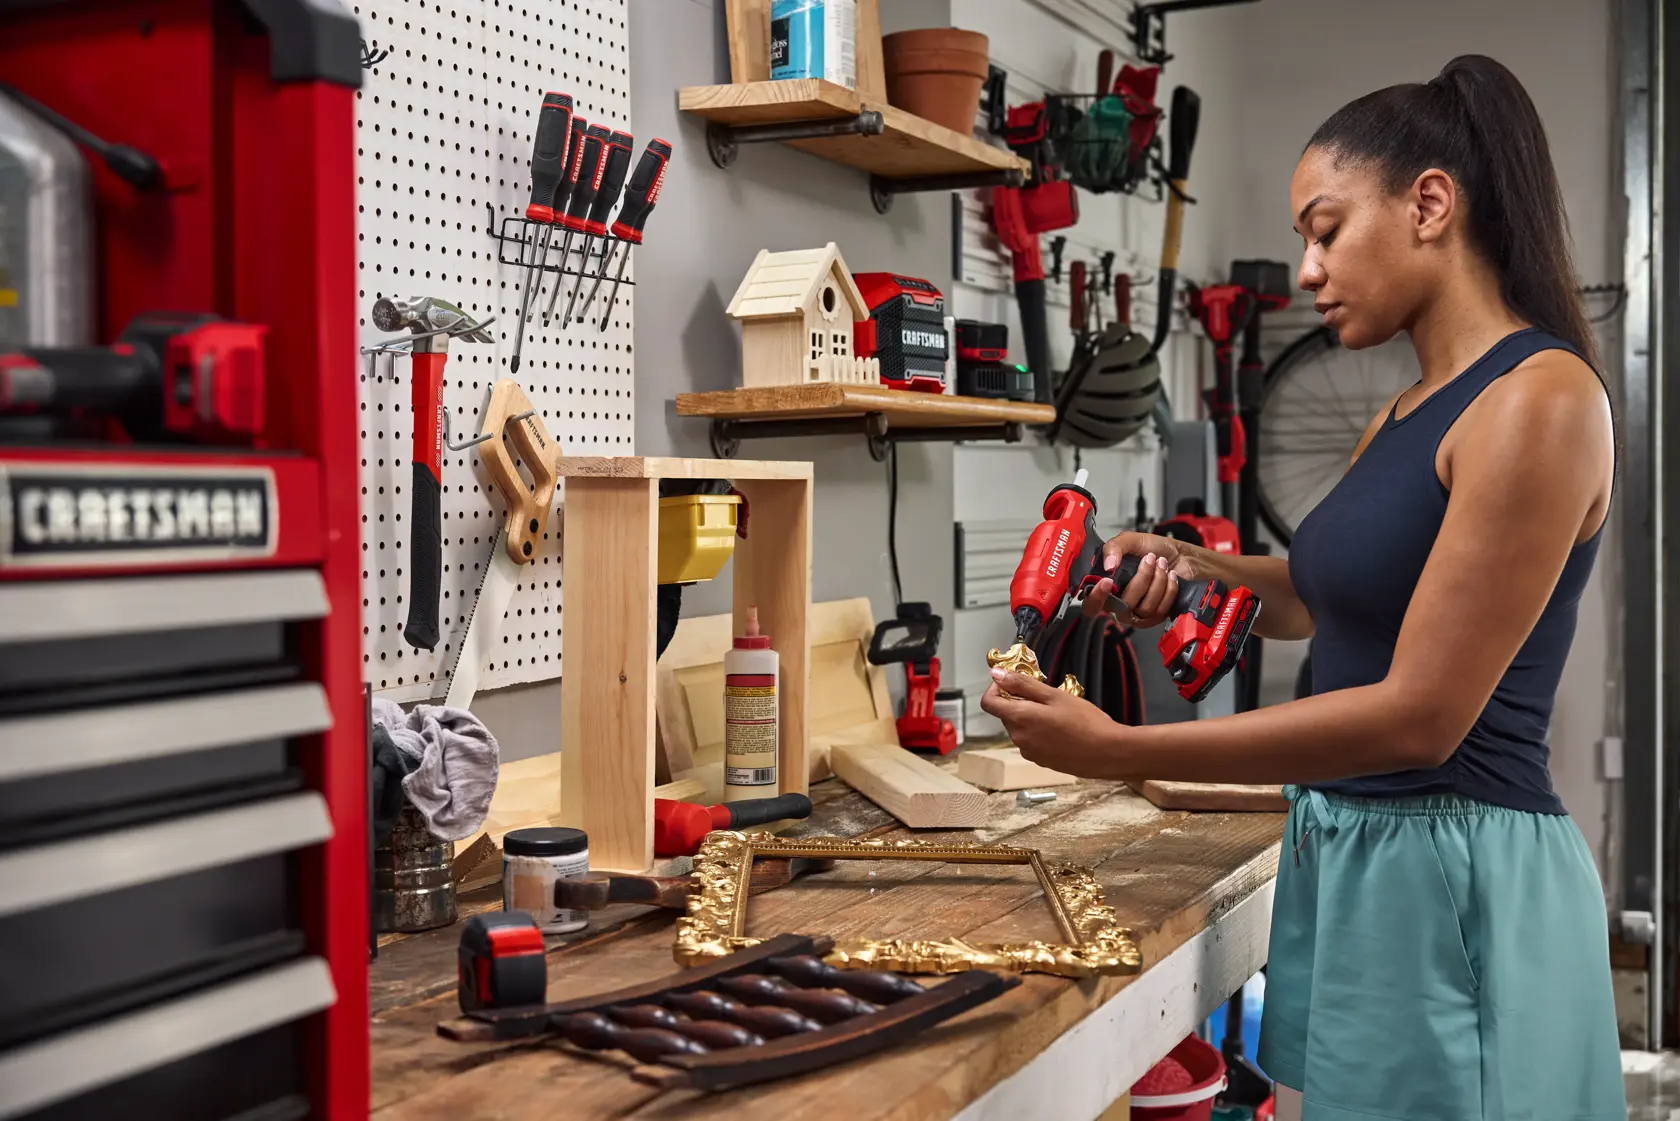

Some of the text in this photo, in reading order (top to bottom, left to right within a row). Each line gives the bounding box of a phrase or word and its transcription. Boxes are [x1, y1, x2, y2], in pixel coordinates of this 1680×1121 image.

[572, 135, 587, 182] CRAFTSMAN
[594, 144, 610, 190] CRAFTSMAN
[902, 329, 945, 348] CRAFTSMAN
[525, 416, 546, 450] RAFTSMAN
[19, 488, 262, 543] CRAFTSMAN
[1046, 528, 1070, 578] CRAFTSMAN
[1213, 597, 1238, 639] CRAFTSMAN
